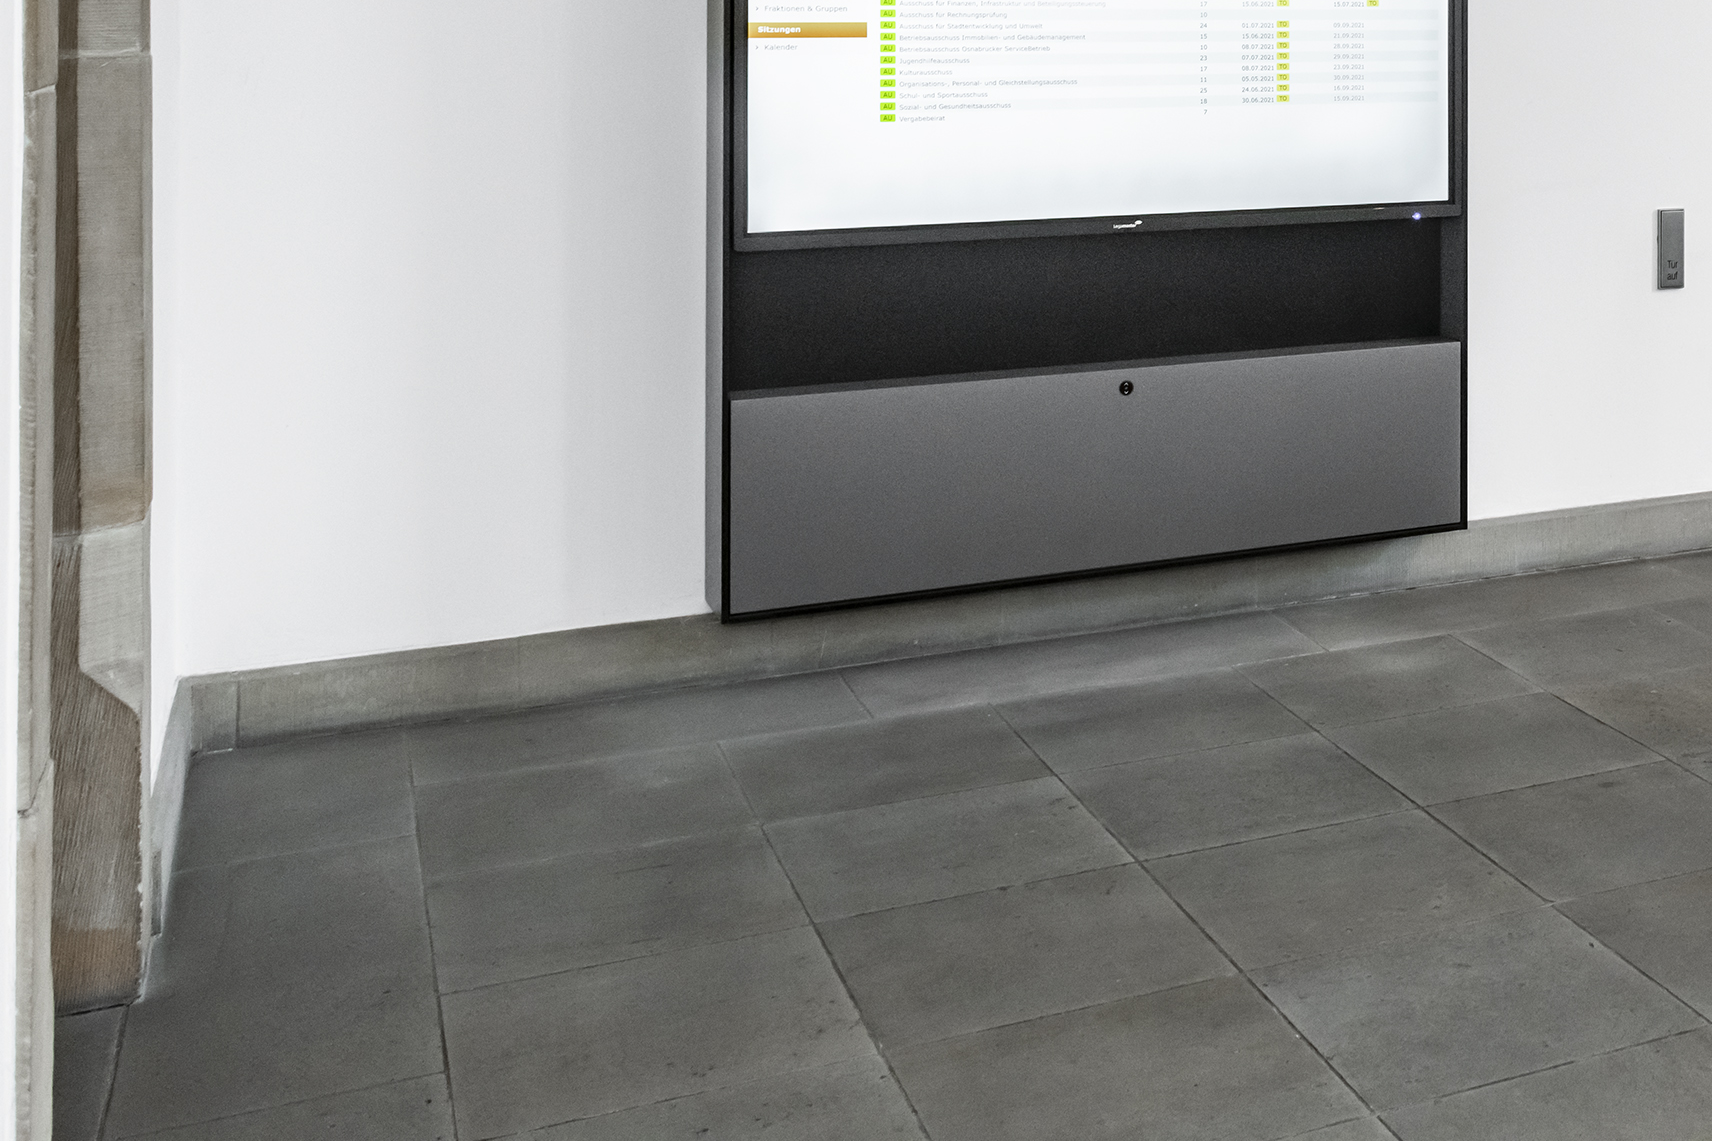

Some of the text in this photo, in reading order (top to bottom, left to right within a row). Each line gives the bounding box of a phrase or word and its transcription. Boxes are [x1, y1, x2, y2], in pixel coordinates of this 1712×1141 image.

[815, 5, 848, 14] Gruppen
[757, 25, 802, 35] Sitzungen
[1667, 271, 1678, 281] auf
